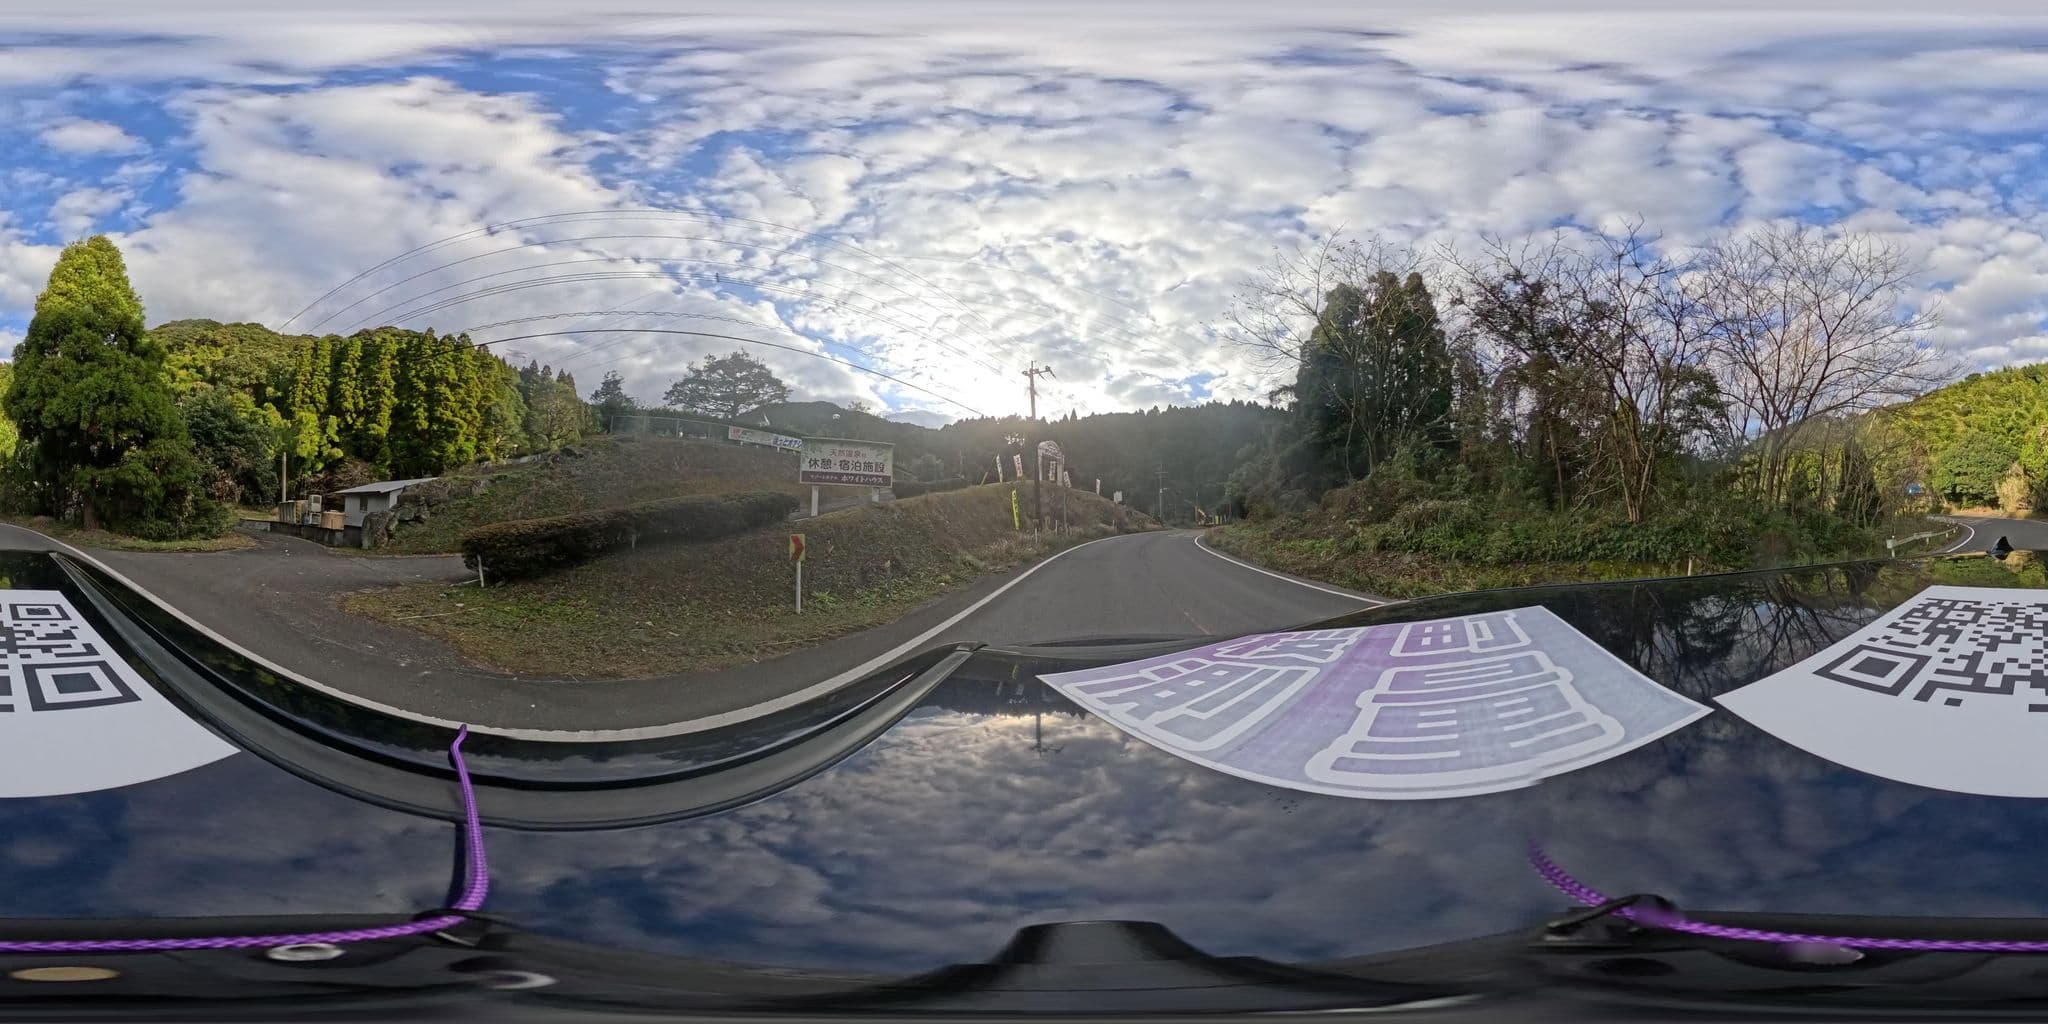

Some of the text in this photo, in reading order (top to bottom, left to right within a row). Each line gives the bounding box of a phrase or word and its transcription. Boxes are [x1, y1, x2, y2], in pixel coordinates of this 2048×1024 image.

[808, 458, 885, 473] 休憩・宿泊施設
[841, 475, 884, 484] ホワイトハウス
[1064, 650, 1625, 786] 測量
